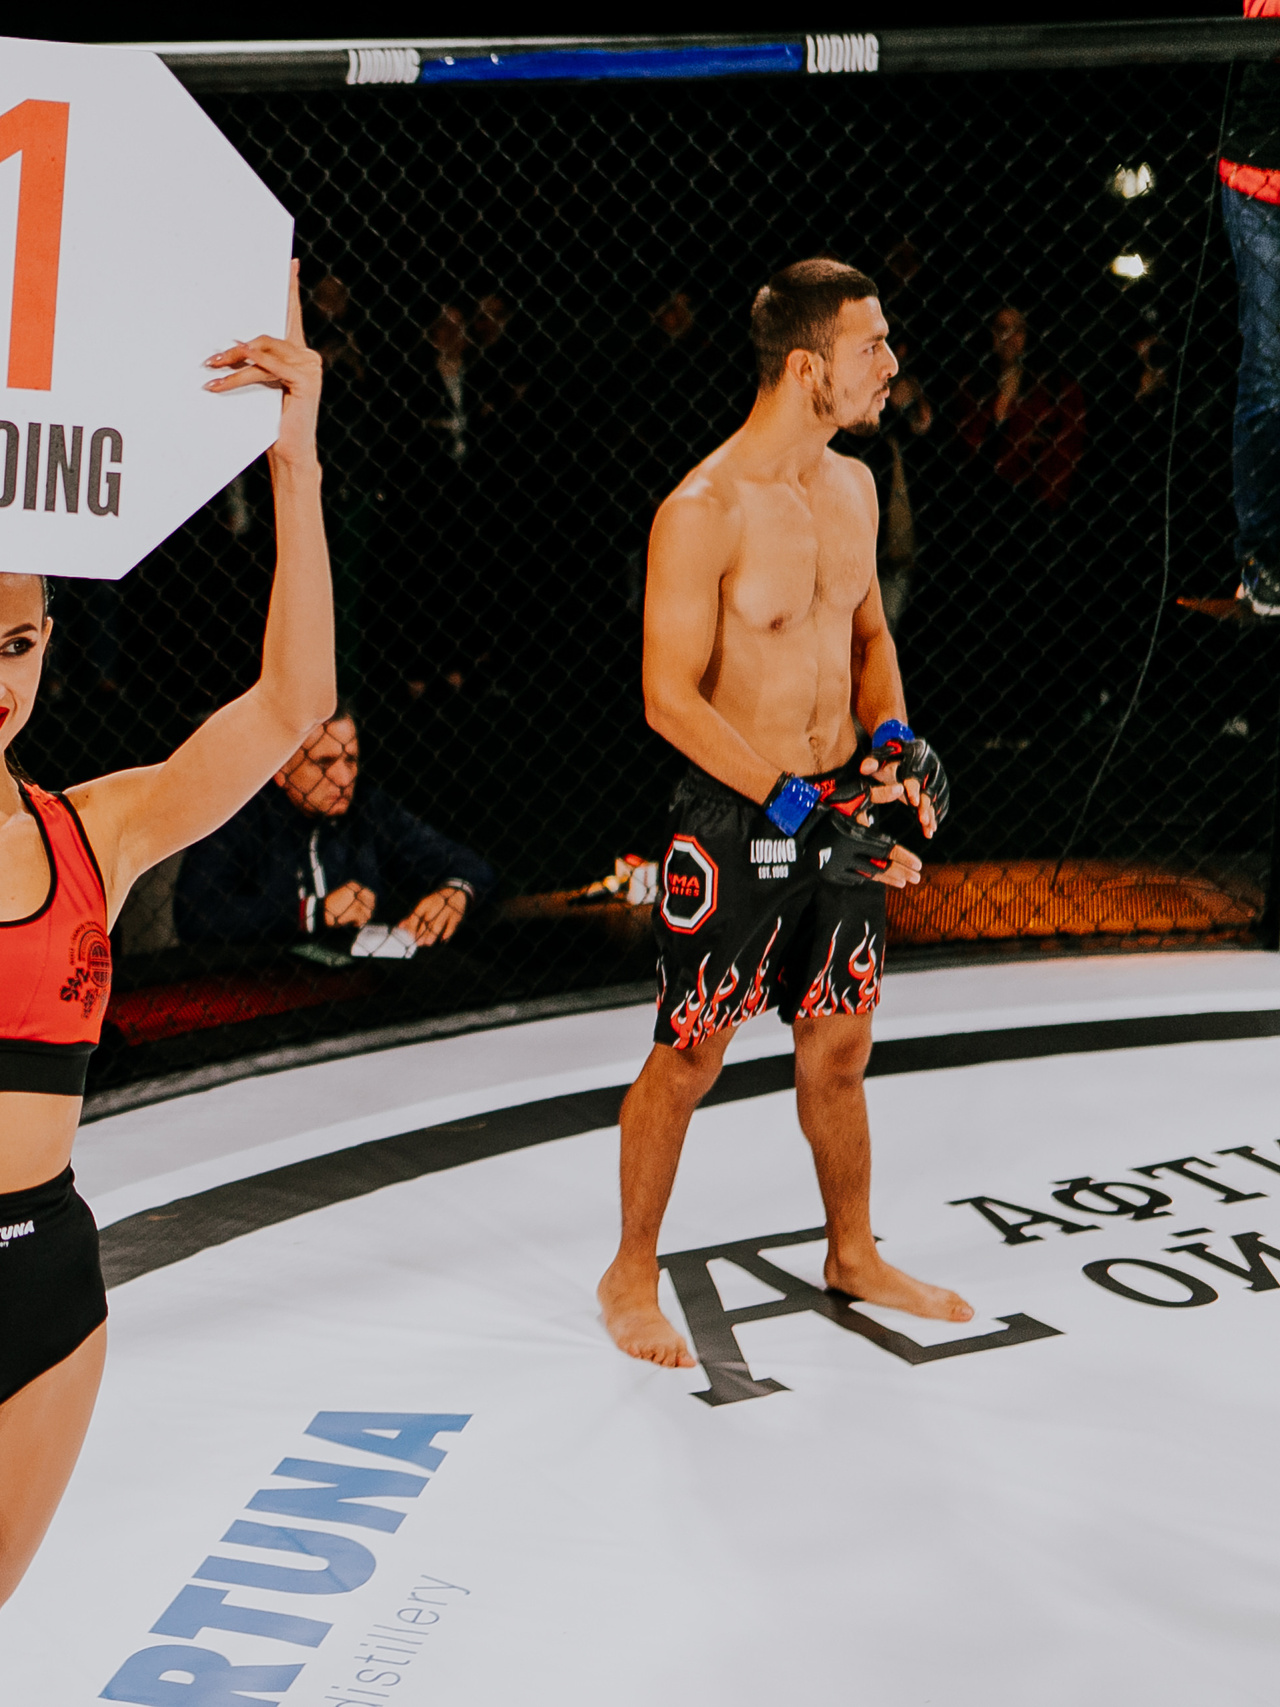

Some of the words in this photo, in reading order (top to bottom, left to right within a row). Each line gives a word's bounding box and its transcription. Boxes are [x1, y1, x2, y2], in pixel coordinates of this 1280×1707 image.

[805, 32, 880, 74] LUDING
[750, 837, 797, 864] LUDING
[97, 1410, 474, 1707] RTUNA
